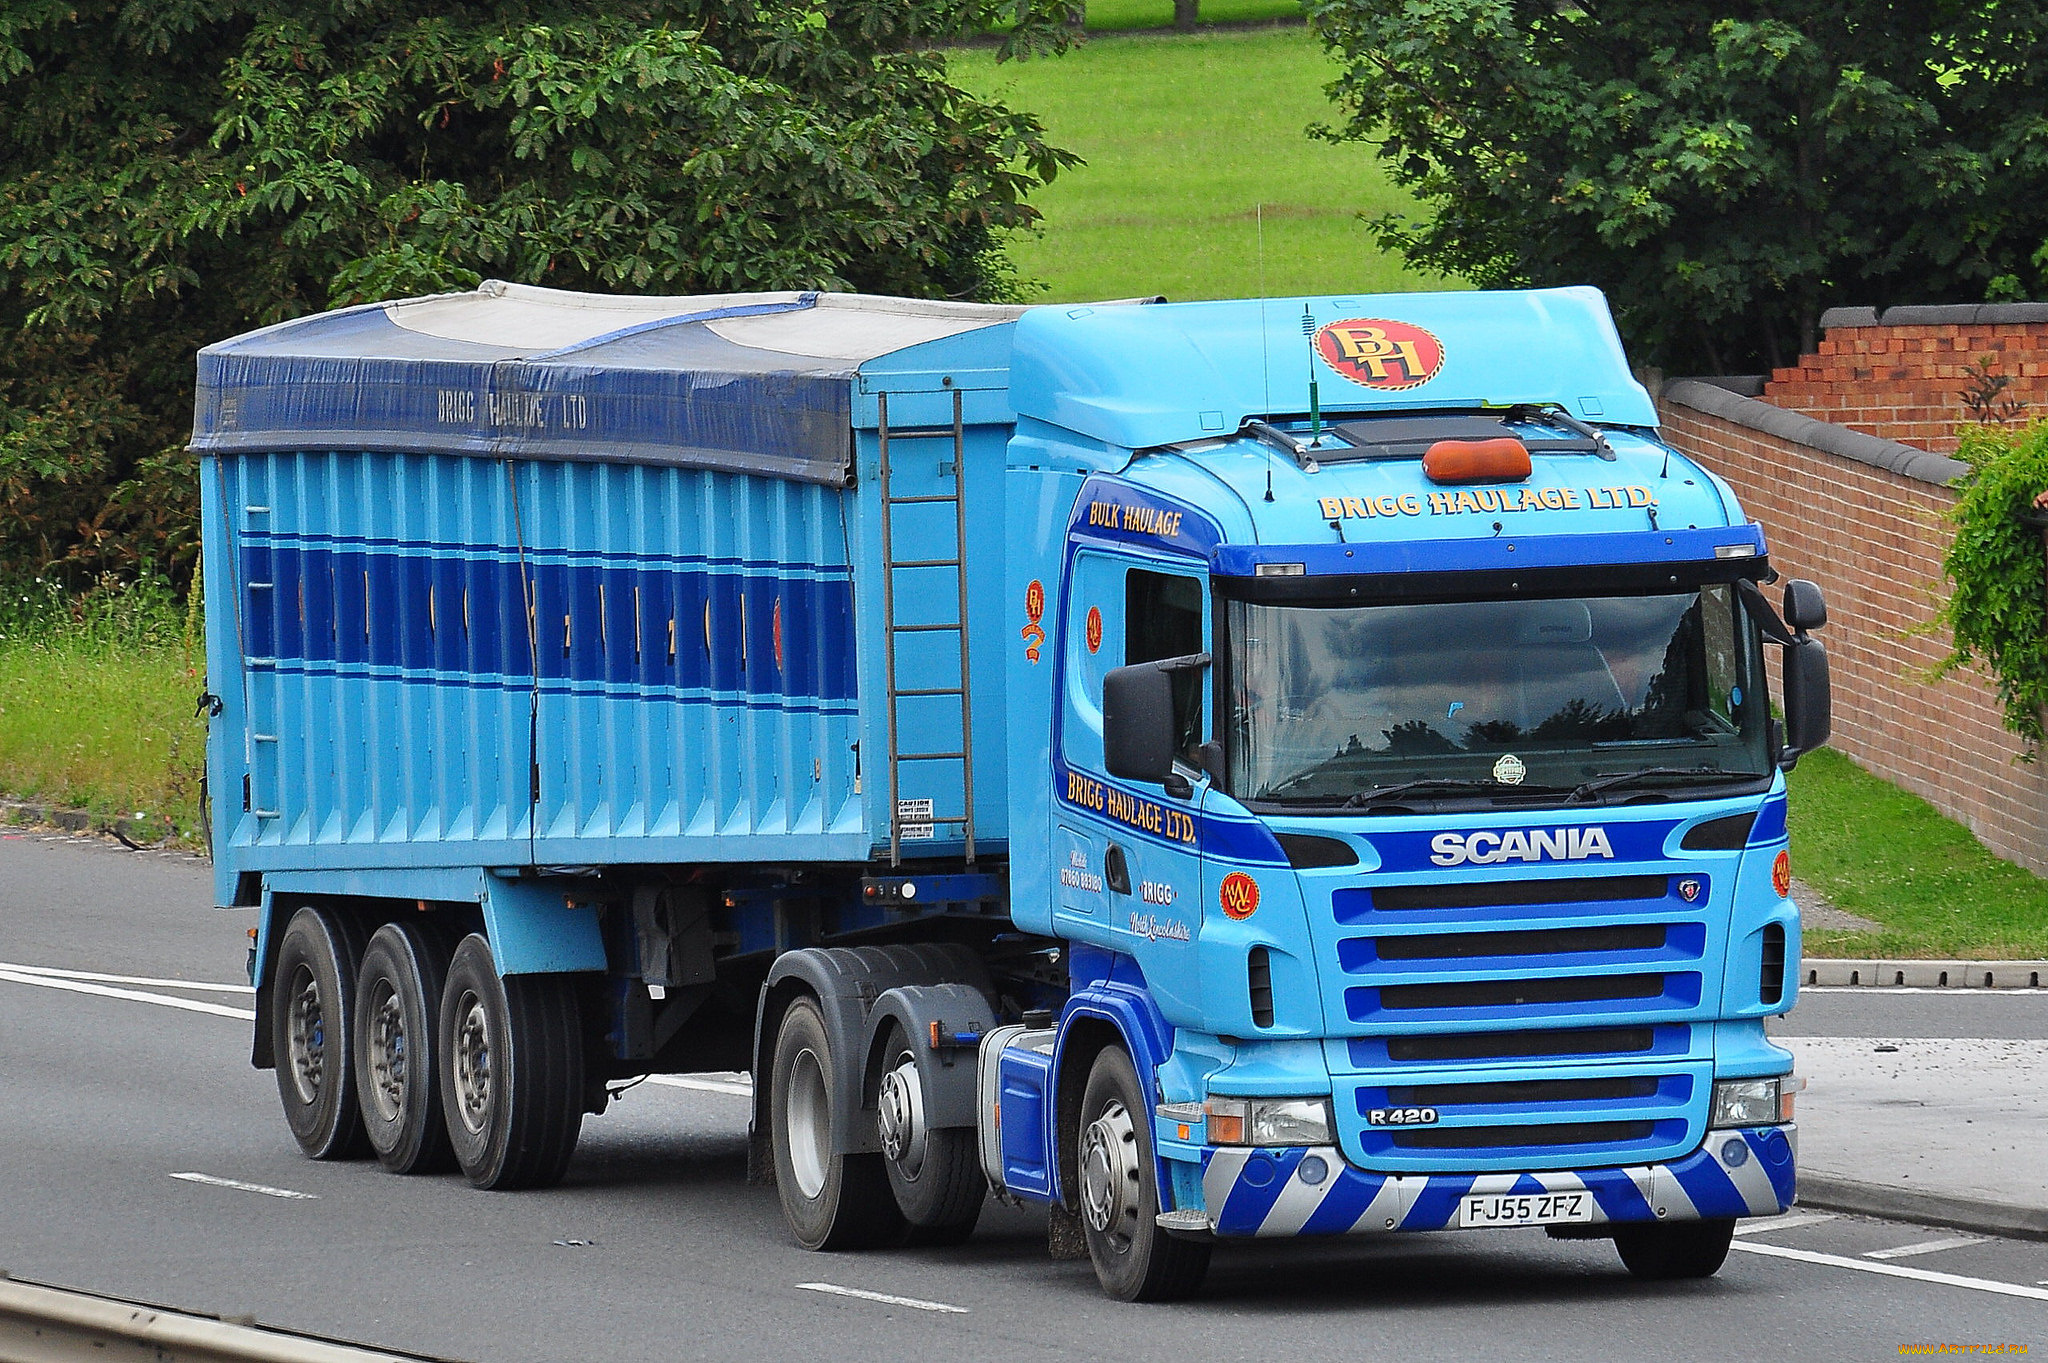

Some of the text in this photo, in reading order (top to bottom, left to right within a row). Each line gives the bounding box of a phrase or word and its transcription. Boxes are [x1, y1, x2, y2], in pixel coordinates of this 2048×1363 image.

[1322, 327, 1427, 381] BH
[438, 390, 474, 423] BRIGG
[562, 394, 587, 429] LTD
[1089, 501, 1182, 537] BULK HAULAGE
[1318, 485, 1661, 520] BRIGG HAULAGE LTD.
[1067, 771, 1197, 844] BRIGG HAULAGE LTD.
[1430, 827, 1614, 866] SCANIA
[1142, 881, 1173, 905] BRIGG
[1370, 1108, 1436, 1125] R 420
[1470, 1195, 1583, 1221] FJ55 ZFZ
